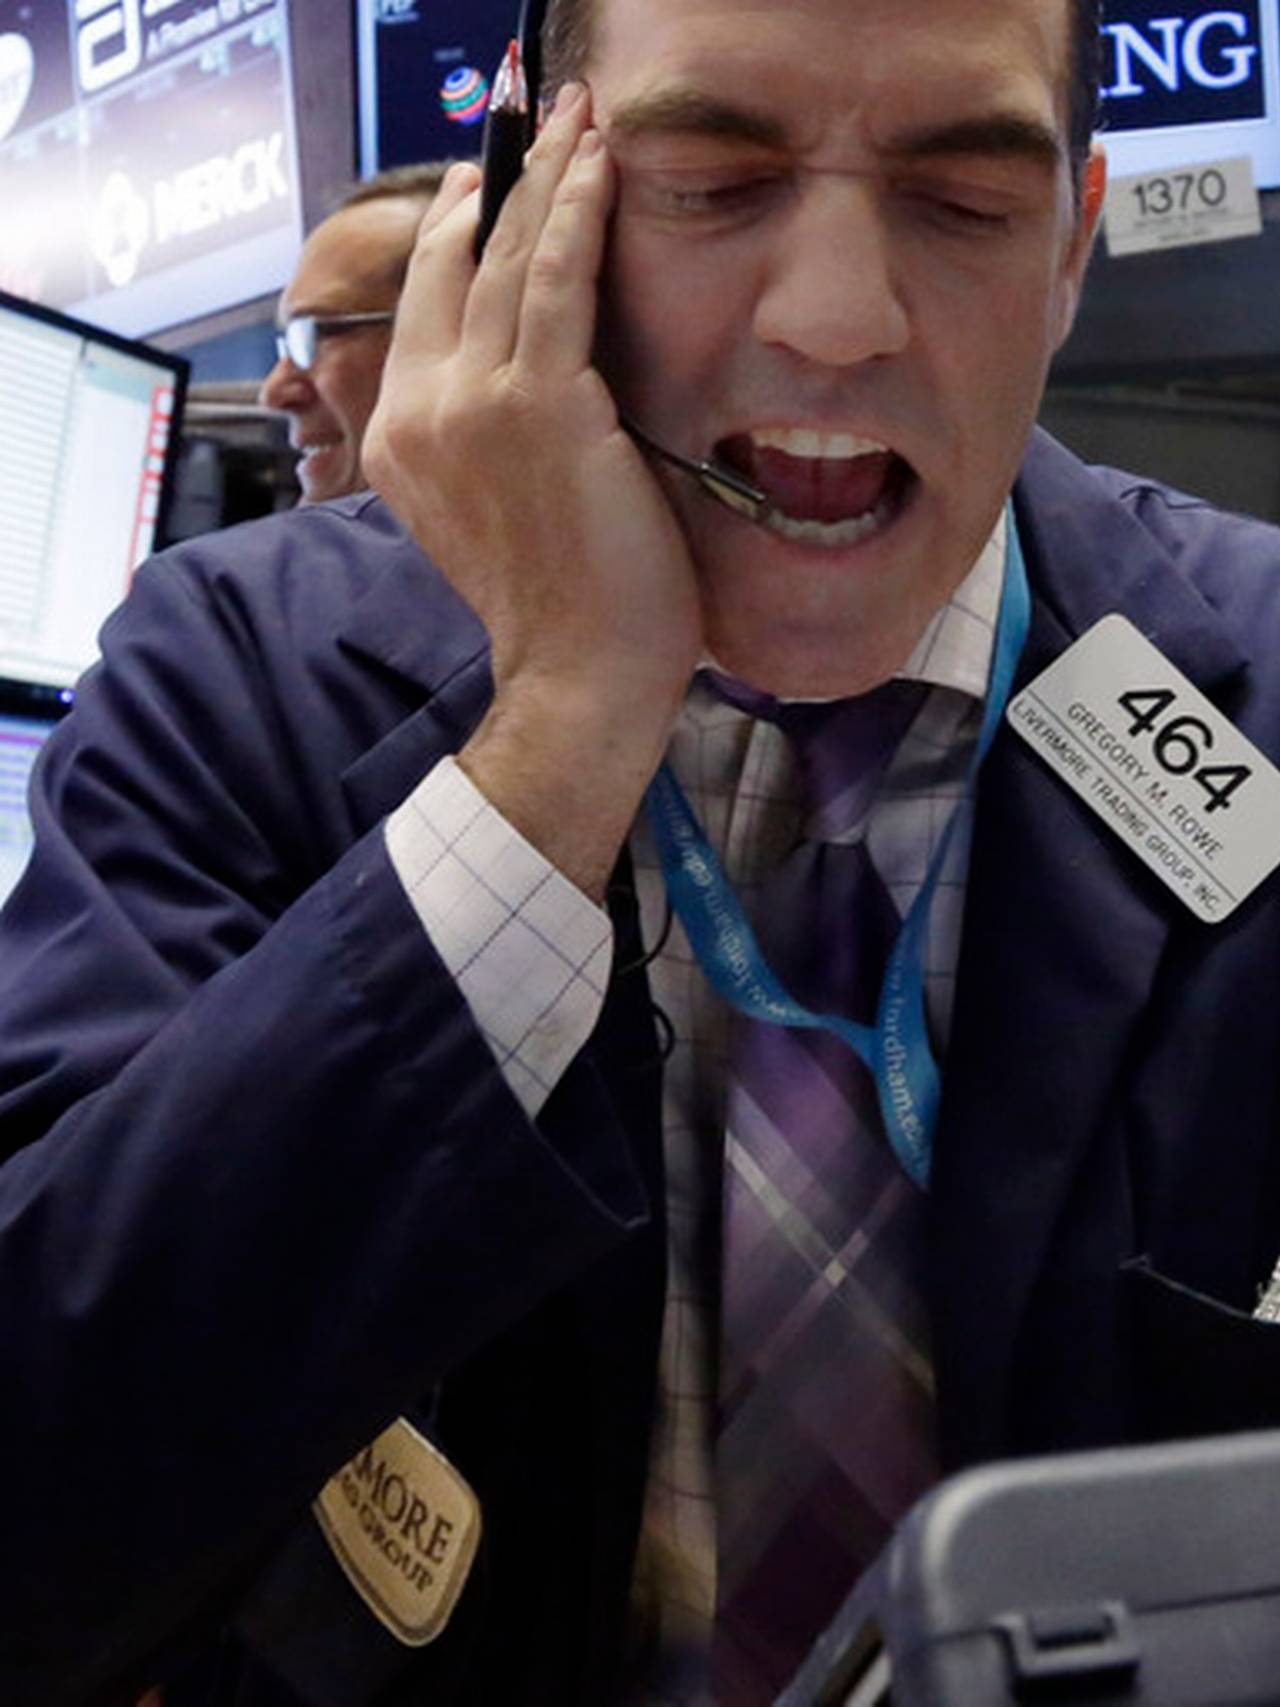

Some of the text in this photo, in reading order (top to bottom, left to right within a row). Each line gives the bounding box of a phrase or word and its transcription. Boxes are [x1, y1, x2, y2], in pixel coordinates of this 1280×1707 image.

[1099, 11, 1258, 98] NG
[154, 132, 288, 243] MERCK
[1133, 168, 1227, 215] 1370
[1012, 699, 1091, 779] LIVERMORE
[1090, 777, 1149, 837] TRADING
[1067, 702, 1150, 781] GREGORY
[1168, 804, 1223, 861] ROWE
[1117, 688, 1253, 813] 464
